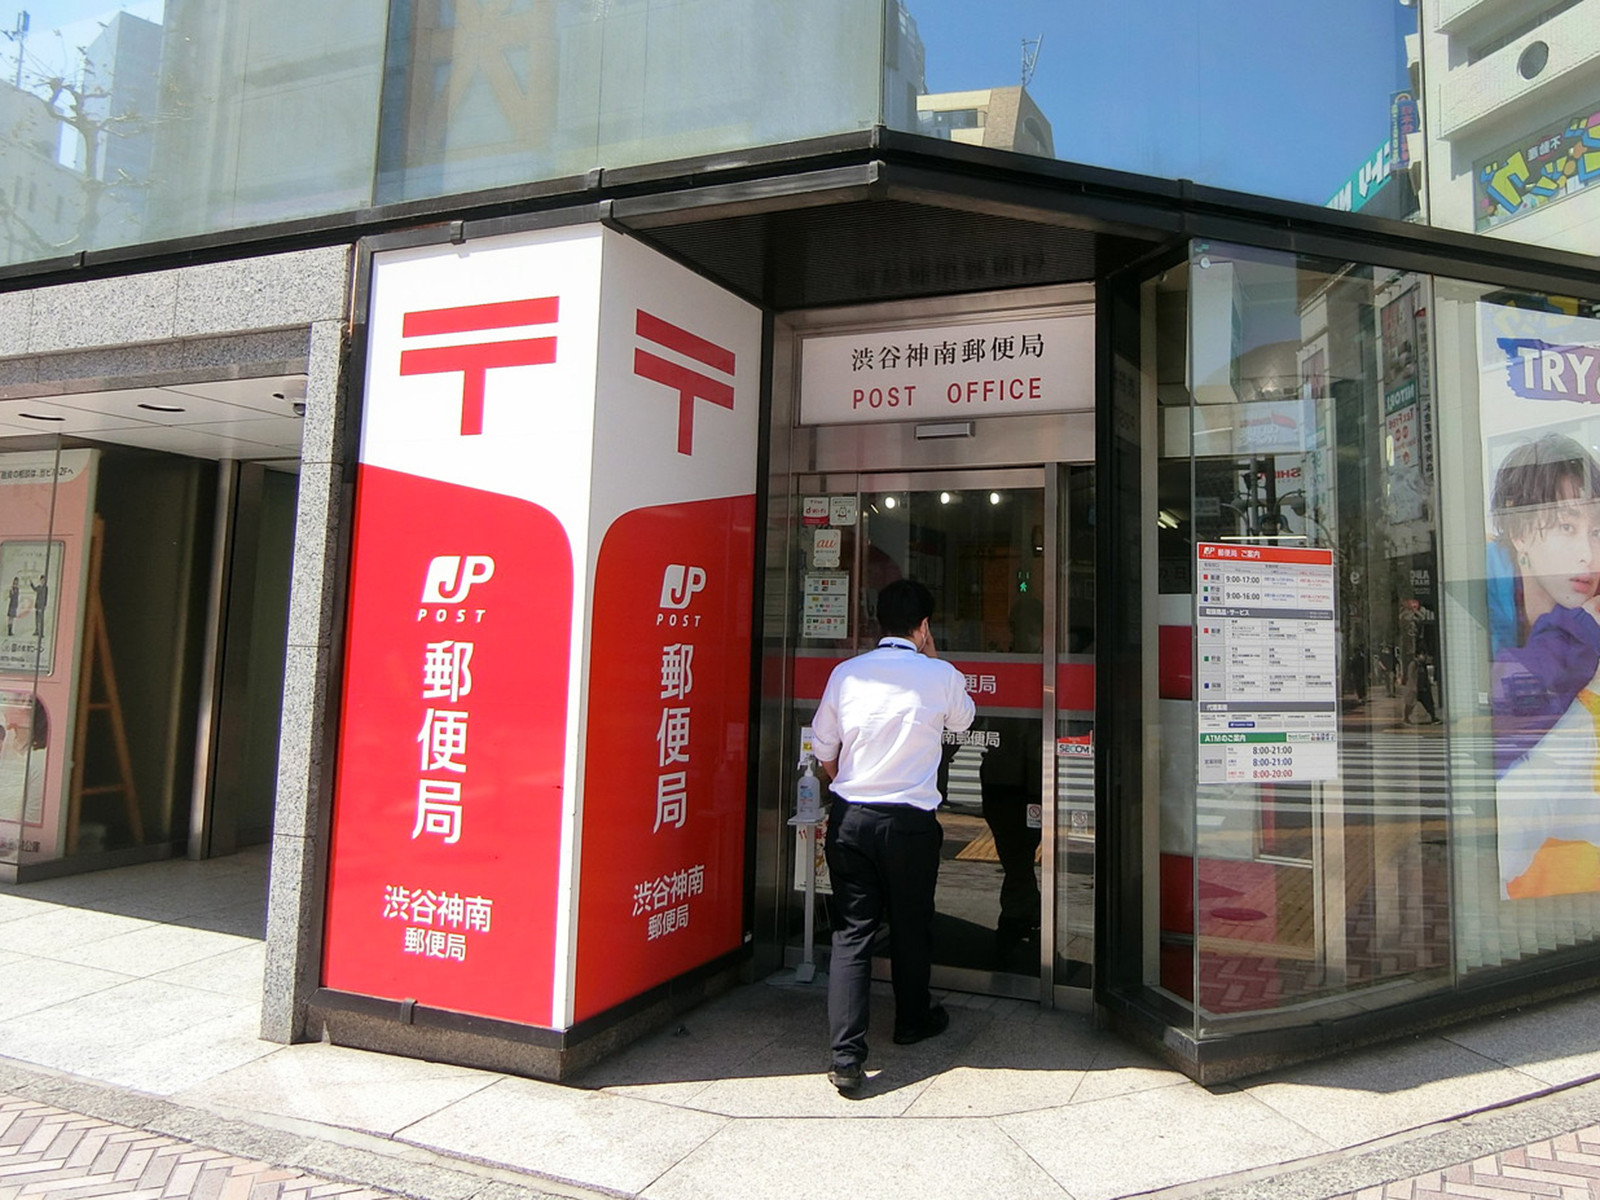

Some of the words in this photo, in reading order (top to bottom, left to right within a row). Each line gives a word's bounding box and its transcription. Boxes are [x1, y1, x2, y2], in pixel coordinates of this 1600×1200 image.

[851, 333, 1044, 371] 渋谷神南郵便局
[853, 386, 916, 409] POST
[947, 377, 1041, 403] OFFICE
[816, 539, 836, 548] au
[1241, 550, 1260, 558] ご案内
[421, 555, 495, 604] JP
[659, 564, 707, 609] JP
[1226, 575, 1260, 583] 9:00-17:00
[1226, 592, 1260, 600] 9:00-16:00
[417, 608, 486, 623] POST
[656, 613, 701, 627] POST
[412, 640, 474, 844] 郵便局
[653, 643, 694, 834] 郵便局
[1059, 744, 1090, 755] SECOM
[1252, 746, 1293, 755] 8:00-21:00
[1252, 758, 1293, 767] 8:00-21:00
[1252, 769, 1293, 779] 8:00-20:00
[632, 864, 705, 917] 渋谷神南
[383, 884, 493, 934] 渋谷神南
[647, 903, 690, 942] 郵便局
[404, 925, 467, 962] 郵便局
